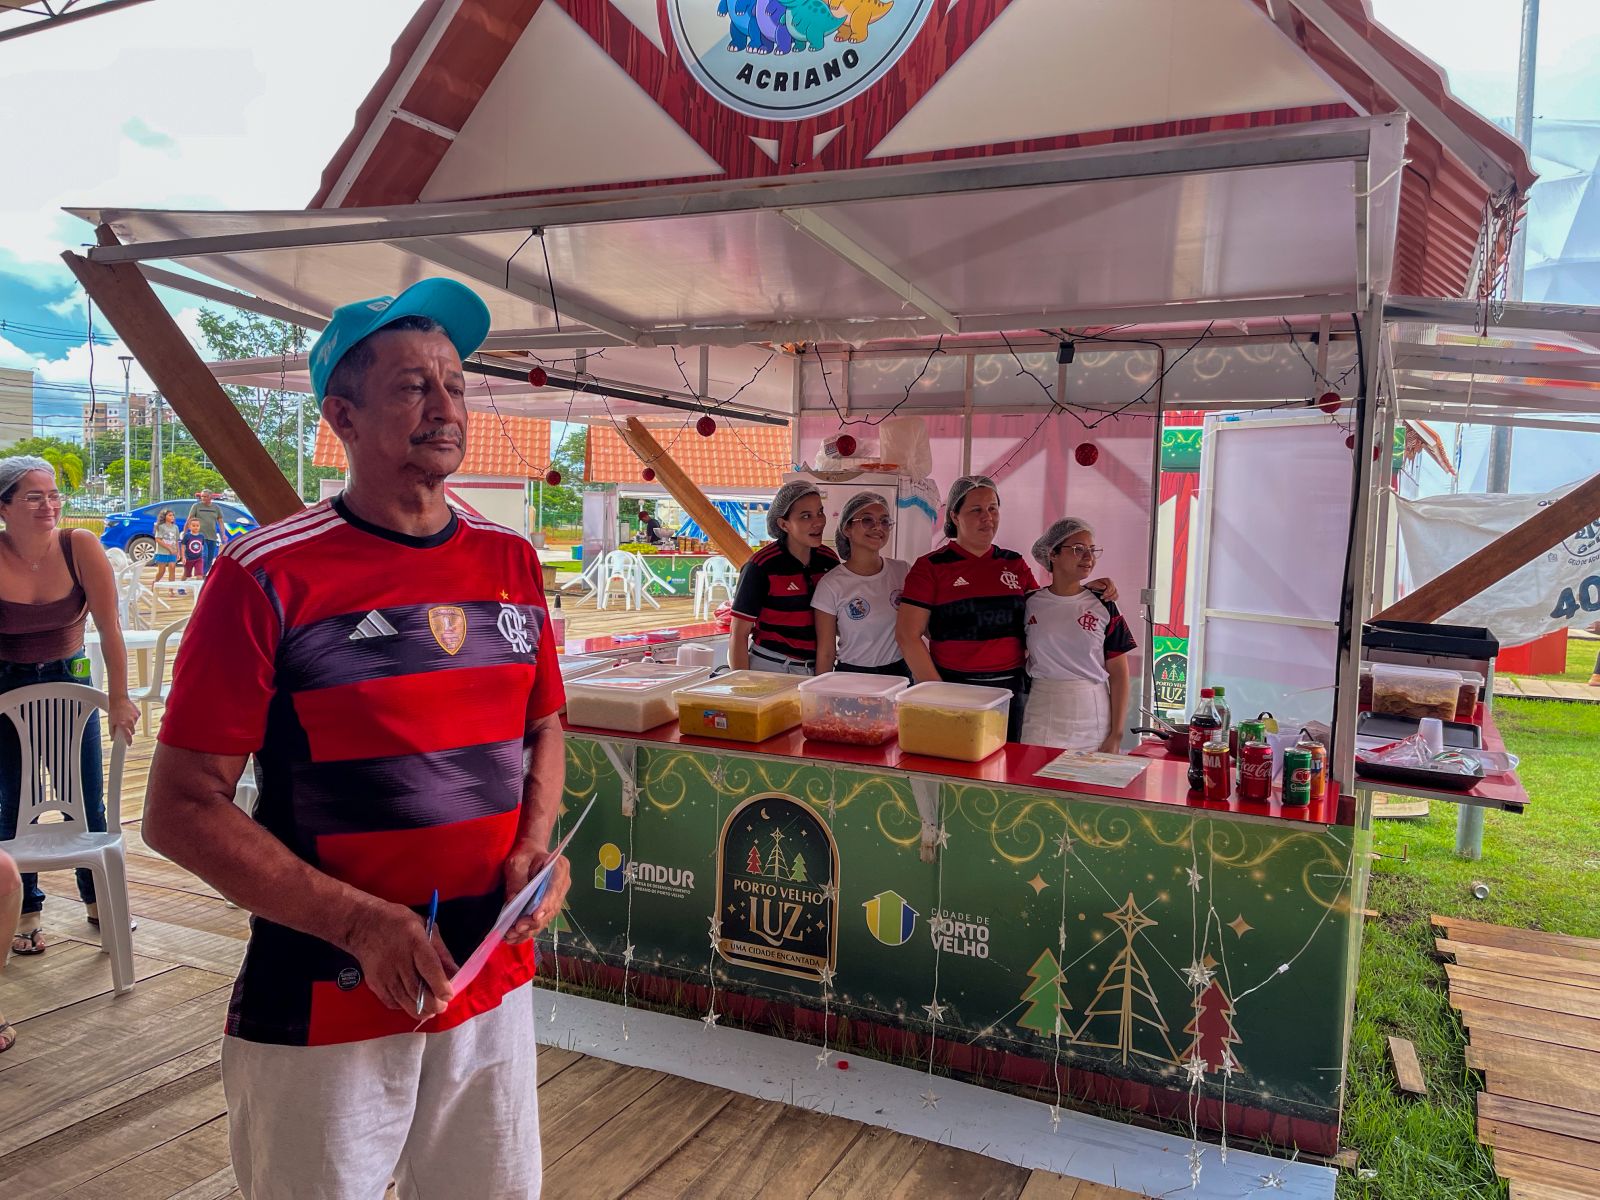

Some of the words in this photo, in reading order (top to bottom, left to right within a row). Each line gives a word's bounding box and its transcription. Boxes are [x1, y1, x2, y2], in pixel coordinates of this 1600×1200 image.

[735, 48, 859, 92] ACRIANO
[1161, 686, 1183, 703] LUZ
[733, 879, 777, 897] PORTO
[779, 887, 824, 905] VELHO
[749, 896, 804, 947] LUZ
[931, 908, 972, 922] CDADE
[976, 916, 990, 926] DE
[931, 917, 990, 943] ORTO
[730, 944, 747, 953] UMA
[748, 947, 776, 959] CIDADE
[776, 953, 821, 967] ENCANTADA
[930, 933, 989, 959] VELHO
